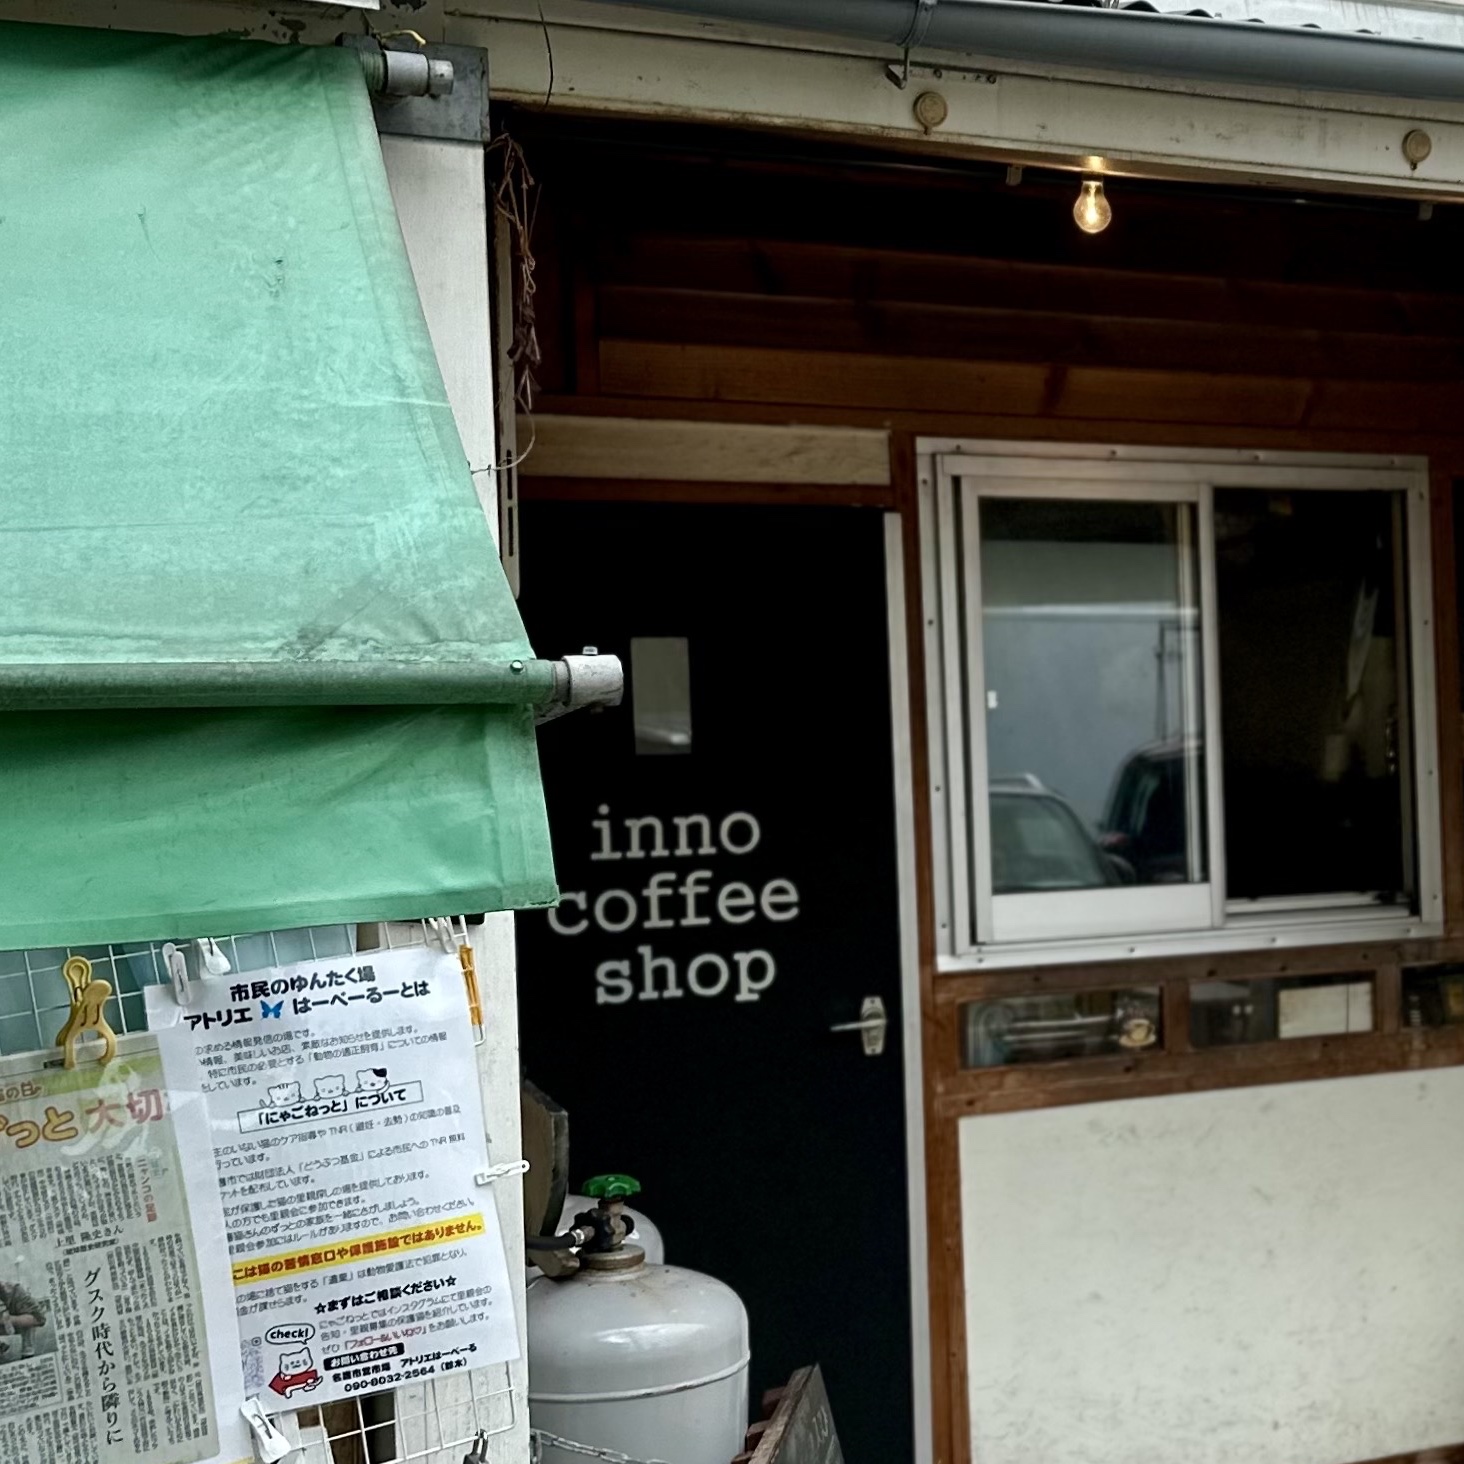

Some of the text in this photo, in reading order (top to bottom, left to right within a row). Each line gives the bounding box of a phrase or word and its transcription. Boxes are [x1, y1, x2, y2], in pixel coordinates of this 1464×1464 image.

[590, 803, 760, 861] inno
[547, 869, 800, 935] coffee
[229, 965, 376, 1003] 市民のゆんたく場
[595, 945, 776, 1005] shop
[184, 980, 431, 1031] アトリエ はーべーるーとは
